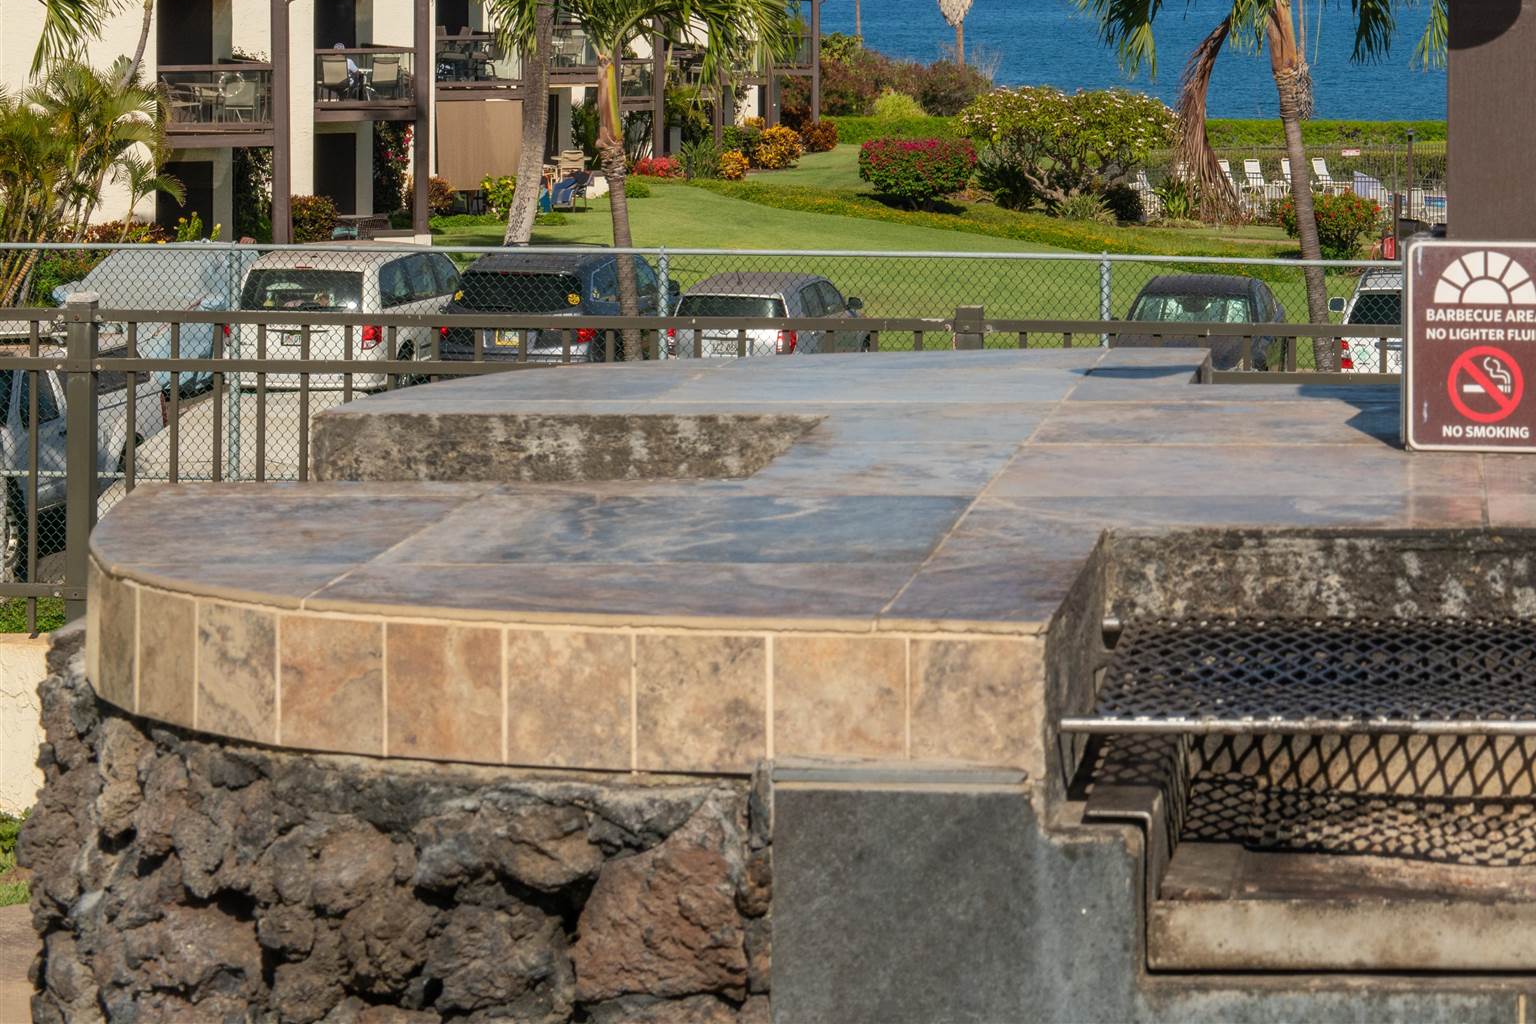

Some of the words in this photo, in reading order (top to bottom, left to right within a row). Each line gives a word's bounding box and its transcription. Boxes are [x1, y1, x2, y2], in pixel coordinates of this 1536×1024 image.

[1426, 309, 1502, 322] BARBECUE
[1426, 328, 1447, 340] NO
[1449, 328, 1505, 341] LIGHTER
[1442, 425, 1463, 437] NO
[1465, 426, 1530, 439] SMOKING
